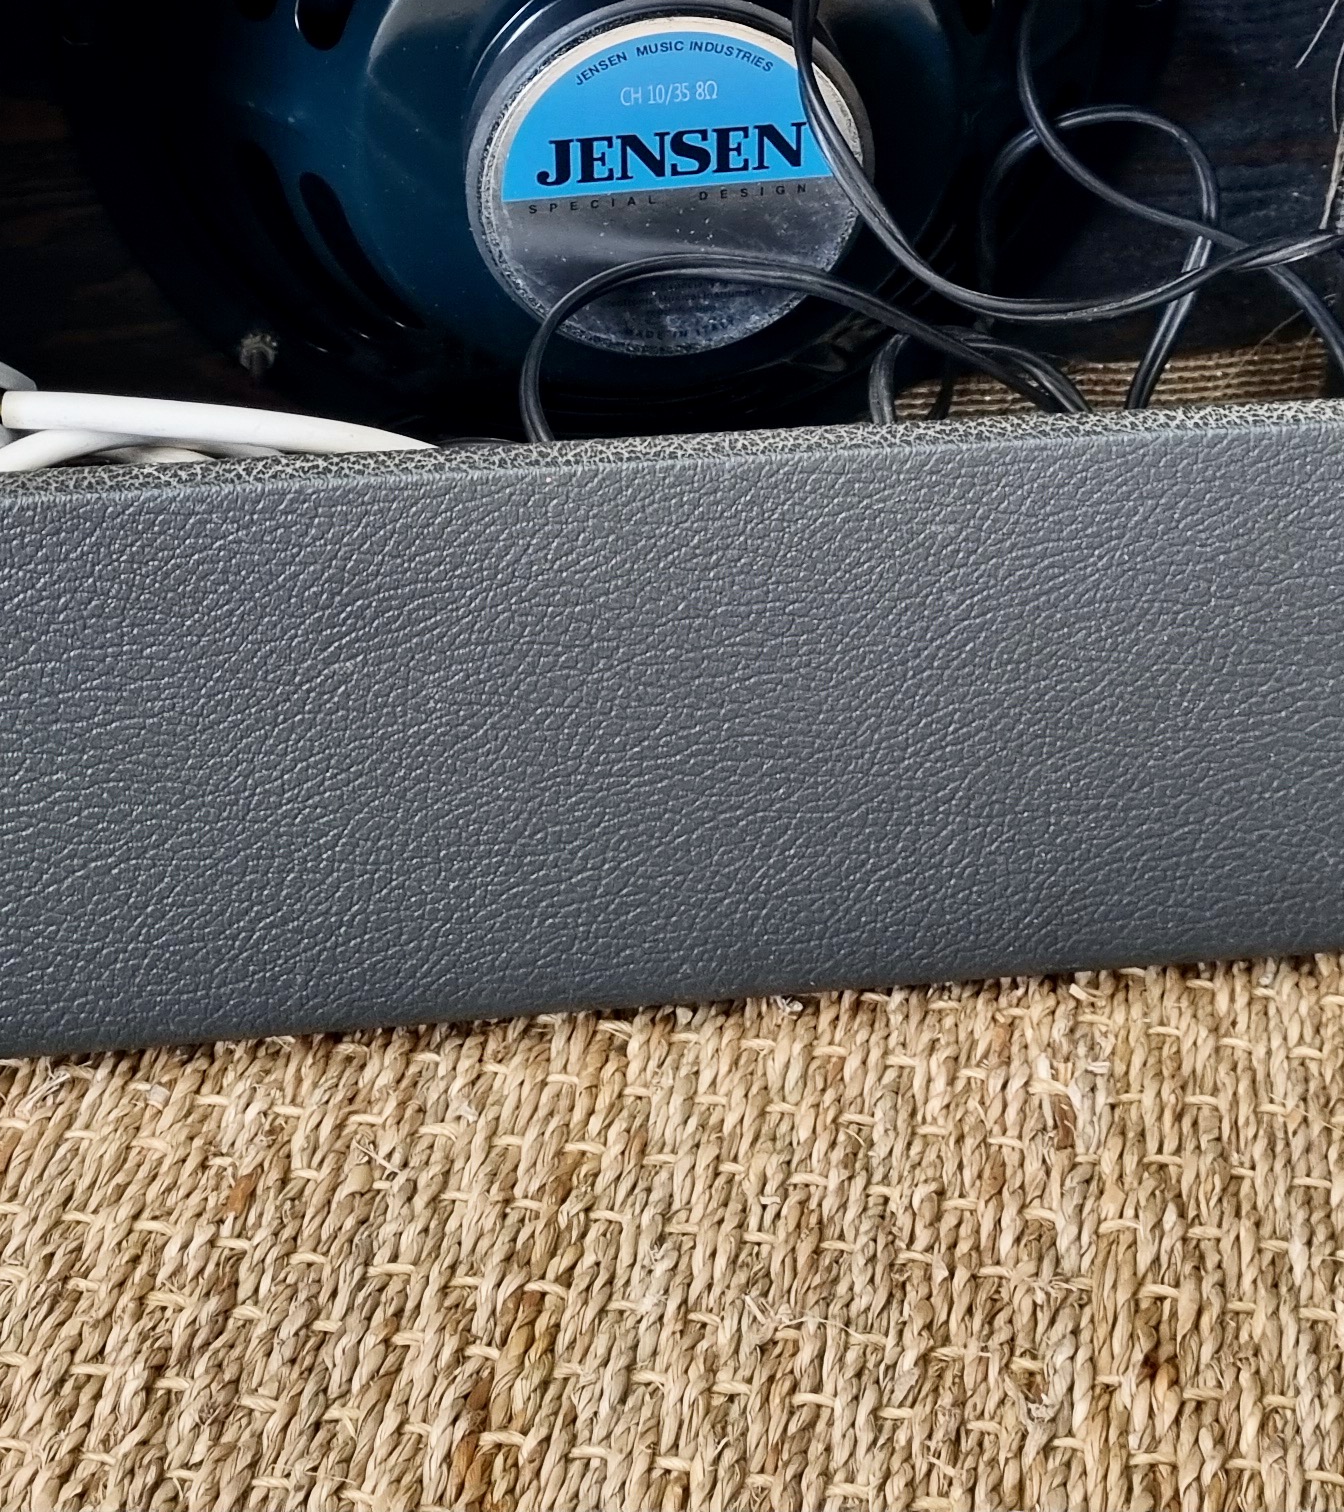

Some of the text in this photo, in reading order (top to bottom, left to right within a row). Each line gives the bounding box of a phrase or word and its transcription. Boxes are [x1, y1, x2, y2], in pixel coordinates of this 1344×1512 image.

[575, 40, 775, 86] JENSEN MUSIC INDUSTRIES
[620, 80, 718, 106] CH 10/35 8Ω
[536, 121, 808, 187] JENSEN
[528, 182, 806, 215] SPECIAL DESIGN
